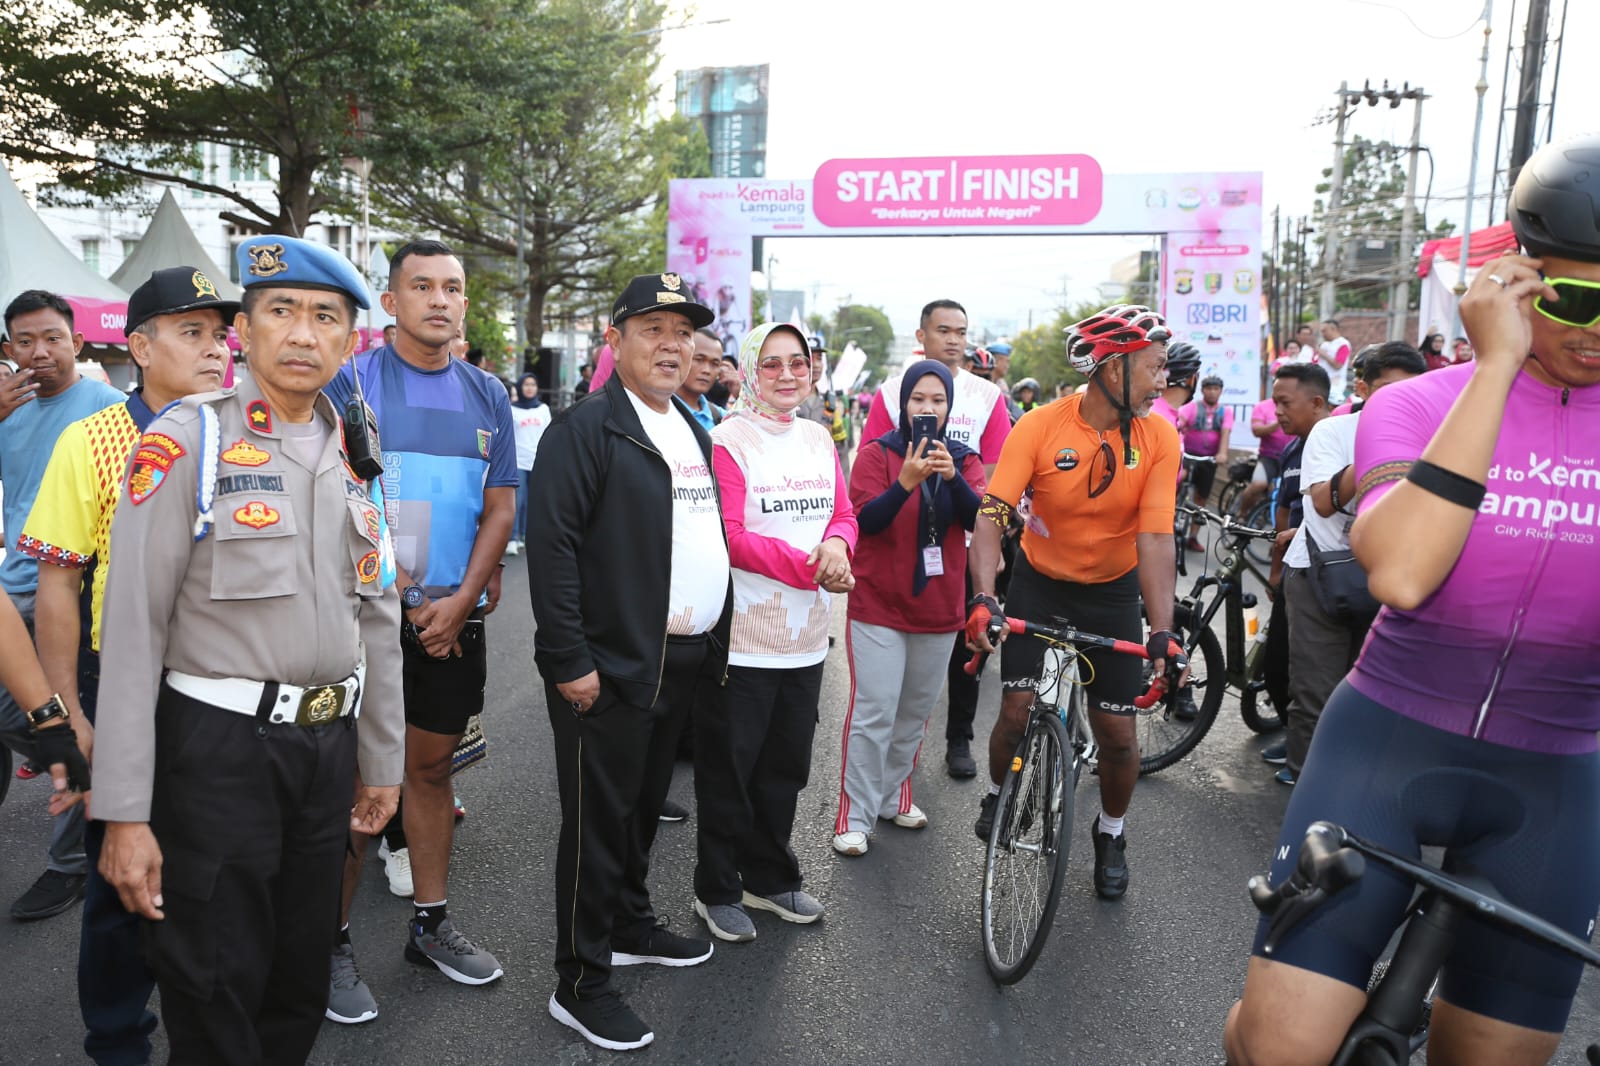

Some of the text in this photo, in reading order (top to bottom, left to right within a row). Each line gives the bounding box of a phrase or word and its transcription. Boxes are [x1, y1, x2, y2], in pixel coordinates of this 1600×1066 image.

[737, 182, 806, 202] Kemala
[836, 166, 1080, 202] START FINISH
[739, 202, 806, 214] Lampung
[942, 206, 985, 219] Untuk
[1211, 304, 1248, 323] BRI
[782, 473, 832, 492] Kemala
[1505, 467, 1525, 482] to
[1477, 491, 1600, 529] ampu
[1494, 524, 1521, 538] City
[1560, 530, 1595, 545] 2023
